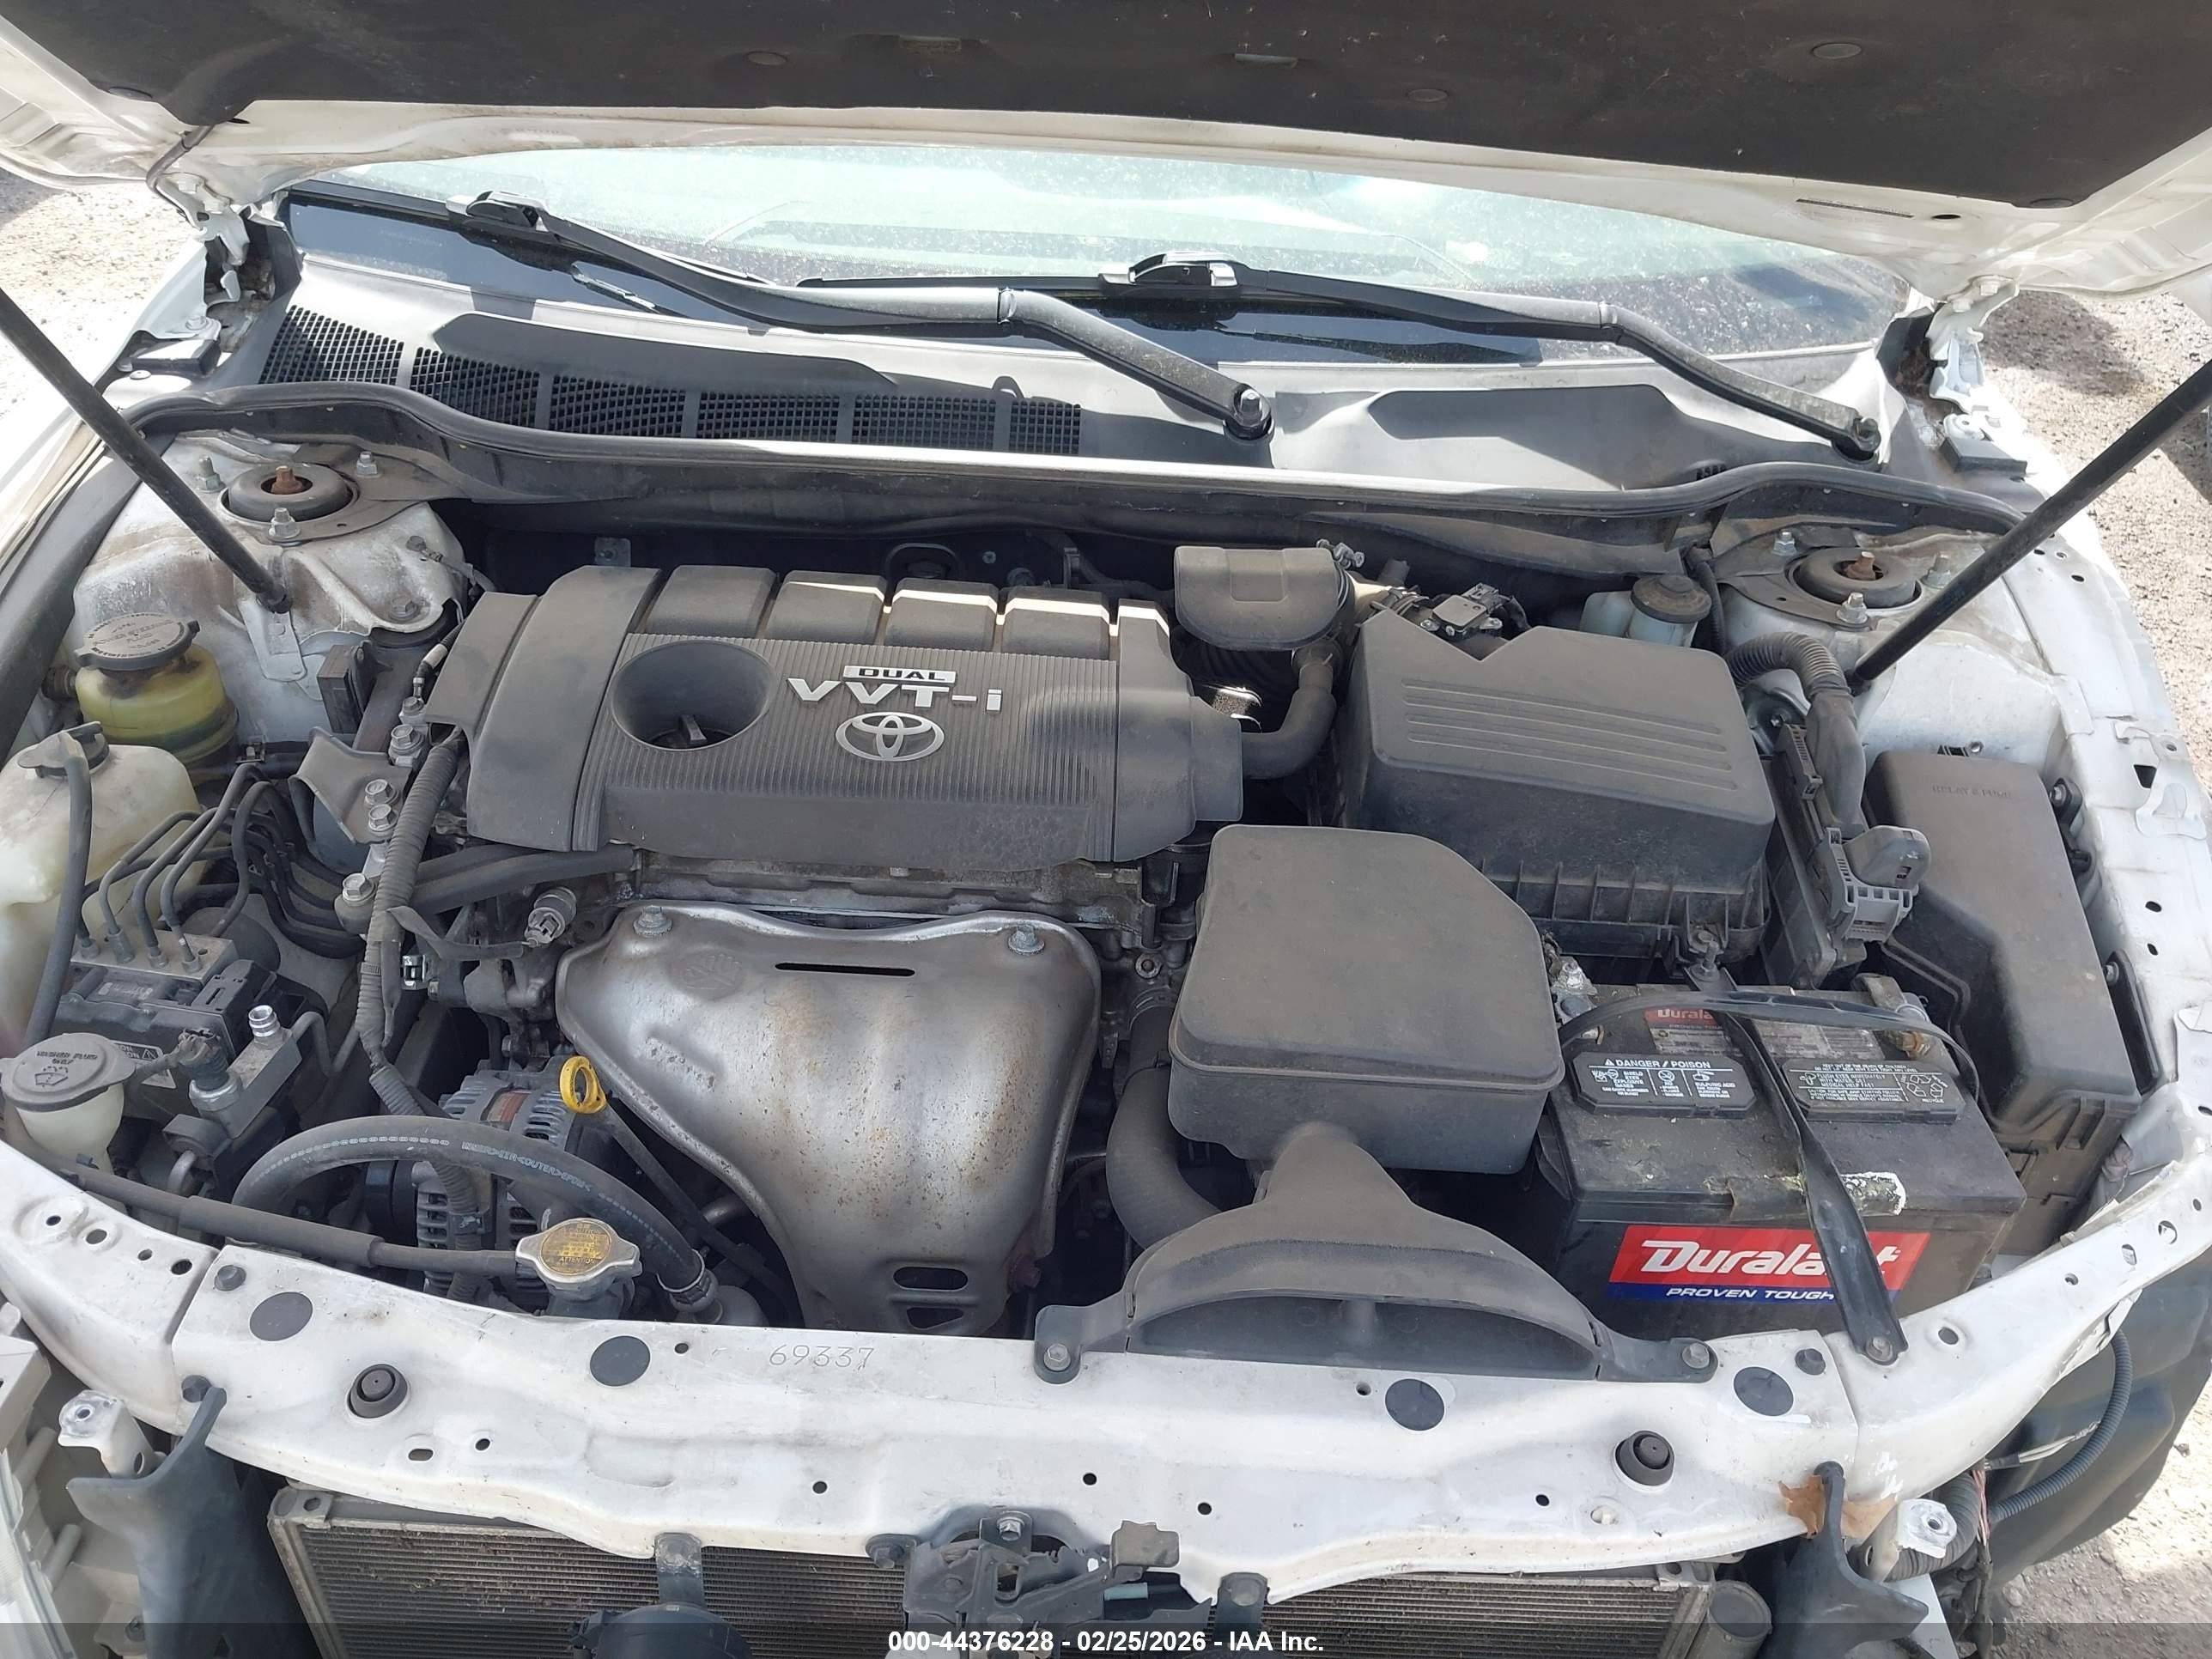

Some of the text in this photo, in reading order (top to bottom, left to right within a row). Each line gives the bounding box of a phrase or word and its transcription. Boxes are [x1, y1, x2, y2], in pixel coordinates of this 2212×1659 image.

[859, 668, 945, 681] DUAL
[787, 678, 1002, 712] VVT-i
[1615, 1059, 1661, 1067] DANGER
[1670, 1060, 1711, 1069] POISON
[1641, 1240, 1902, 1276] Duralat
[1666, 1288, 1757, 1299] PROVEN
[769, 1344, 875, 1368] 69337
